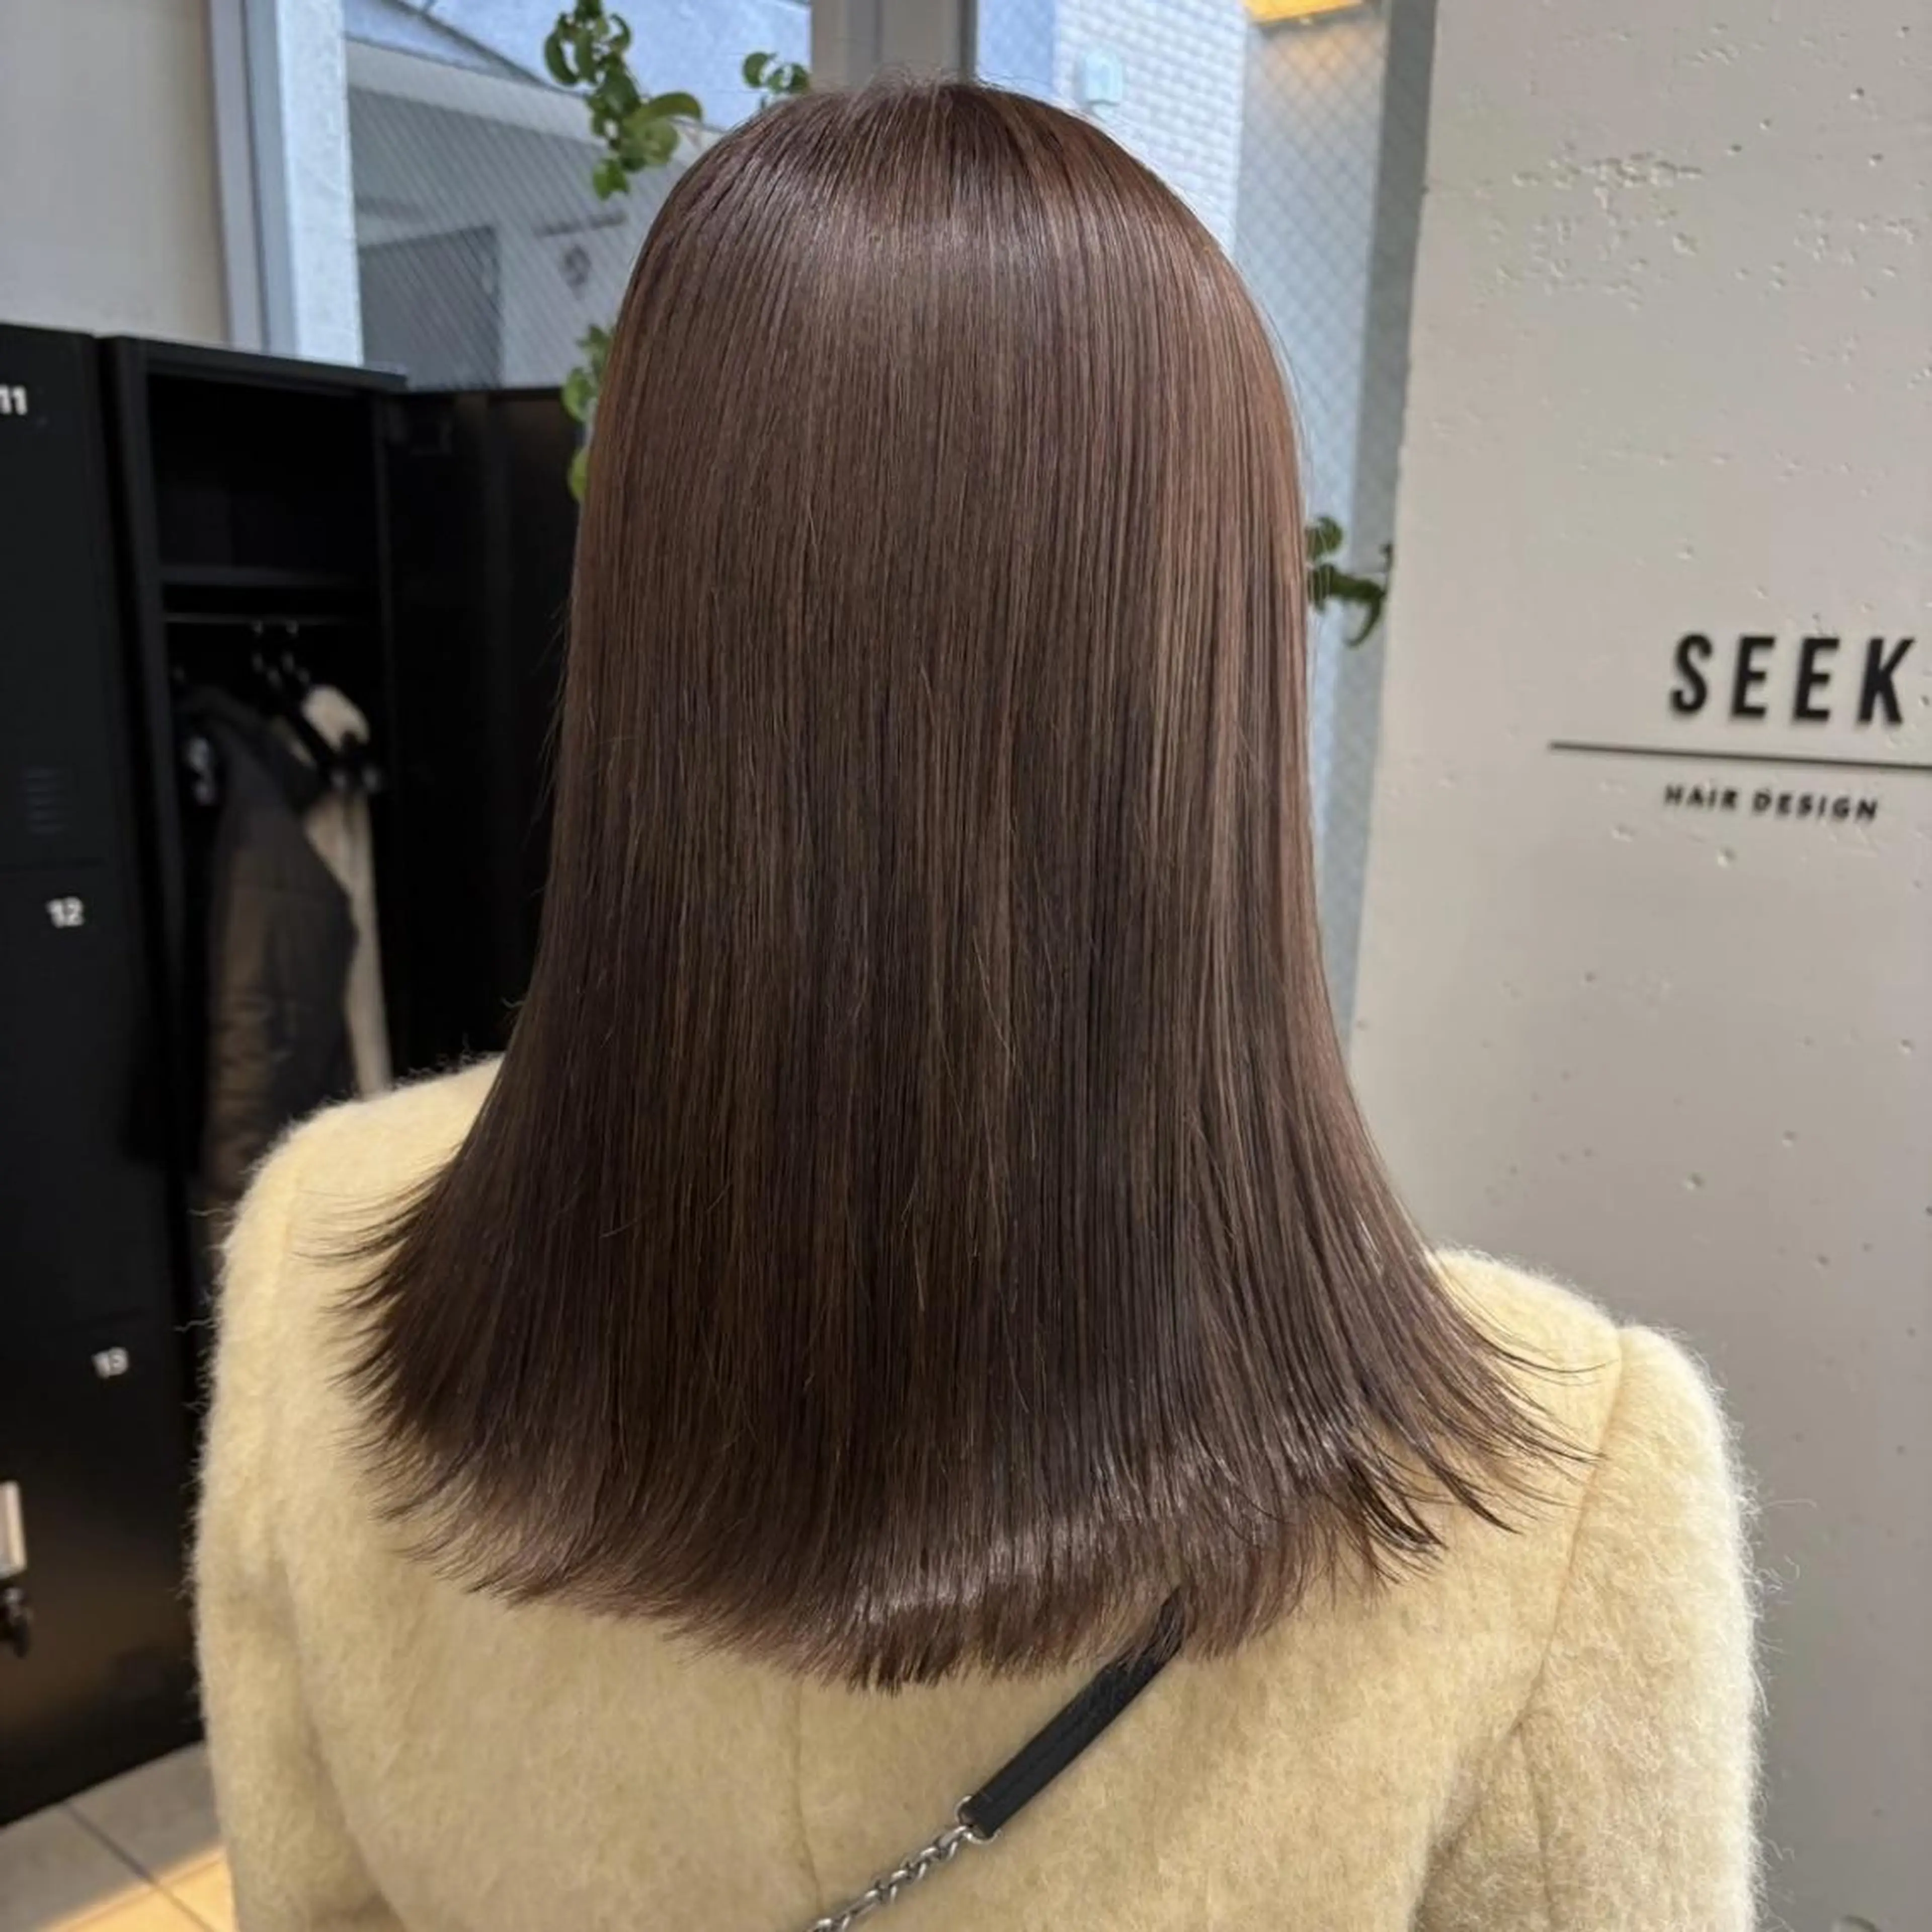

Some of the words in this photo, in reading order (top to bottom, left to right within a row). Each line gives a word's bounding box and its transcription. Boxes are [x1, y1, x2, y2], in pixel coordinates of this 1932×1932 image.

[1670, 633, 1914, 725] SEEK
[1664, 785, 1739, 810] HAIR
[1751, 788, 1879, 822] DESIGN
